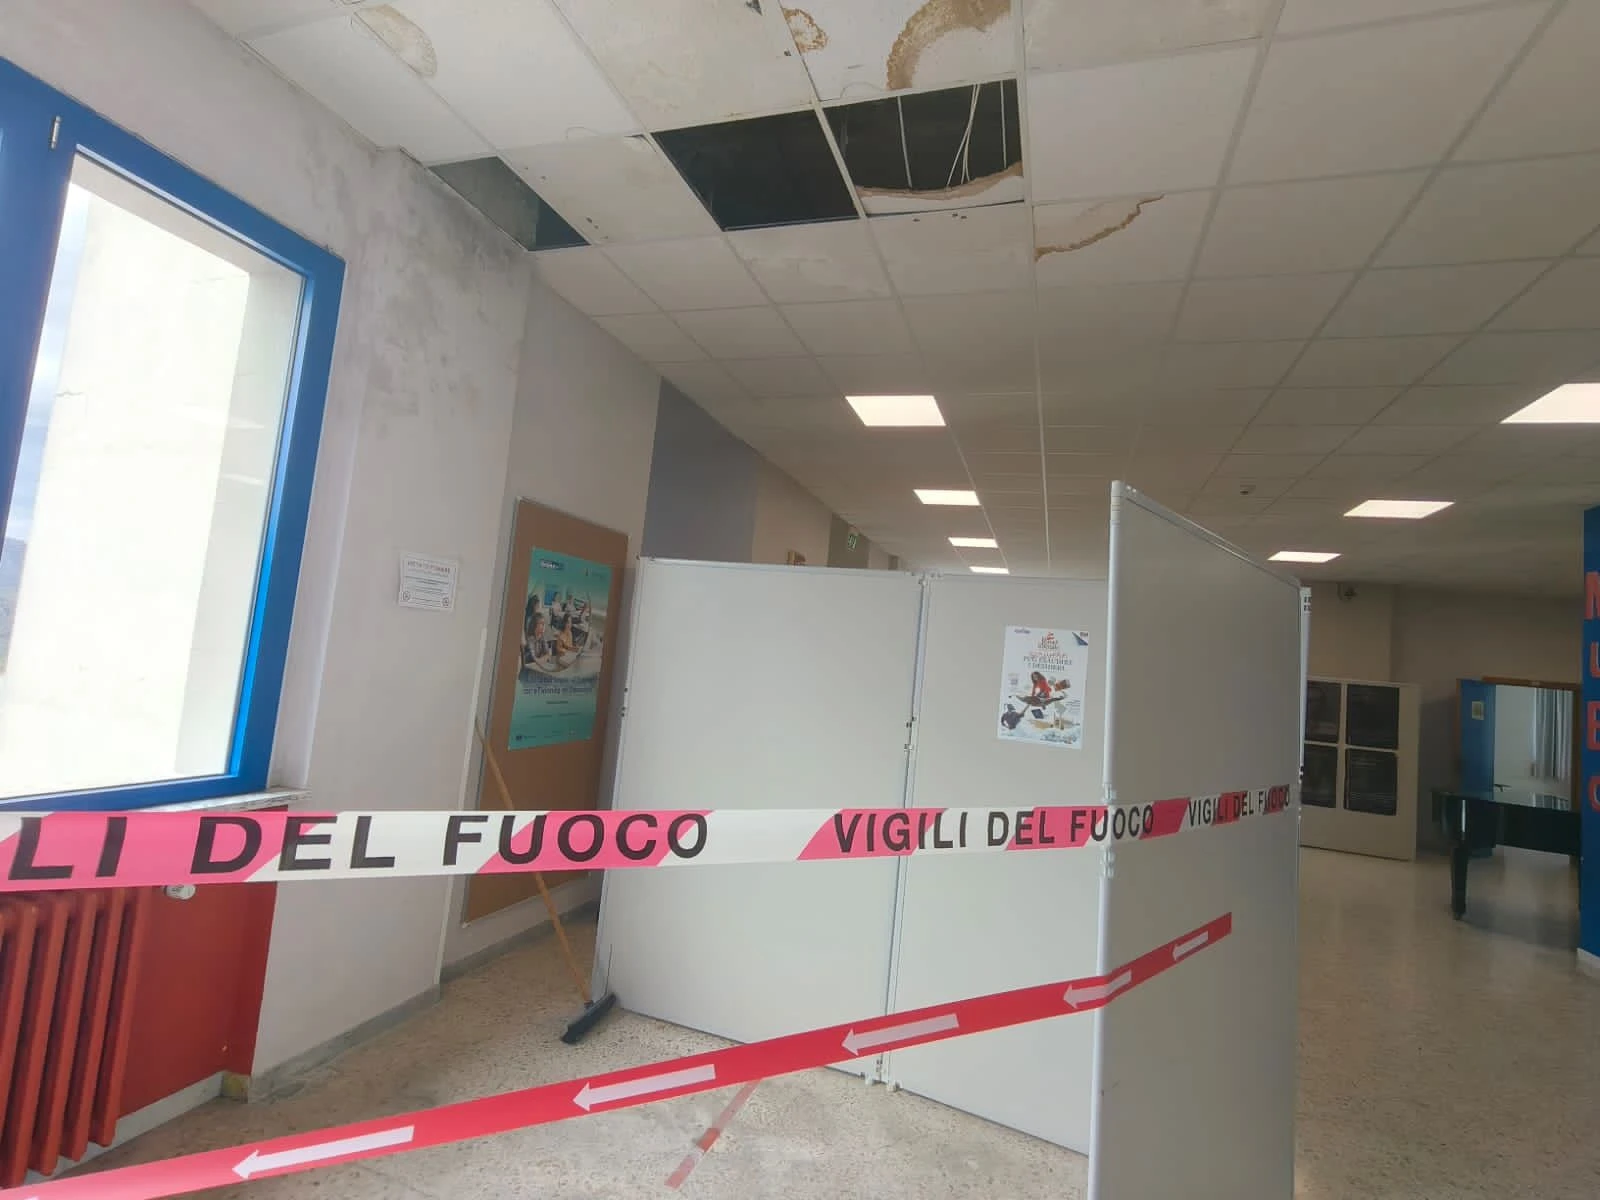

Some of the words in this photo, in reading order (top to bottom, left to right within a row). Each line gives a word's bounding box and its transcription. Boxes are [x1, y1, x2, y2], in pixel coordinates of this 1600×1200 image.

[190, 815, 396, 874] DEL
[442, 813, 708, 867] FUOCO
[833, 811, 969, 853] VIGILI
[987, 810, 1055, 847] DEL
[1070, 804, 1154, 842] FUOCO
[1188, 795, 1229, 827] VIGILI
[1233, 791, 1254, 819] DEL
[1258, 784, 1289, 813] FUOCO
